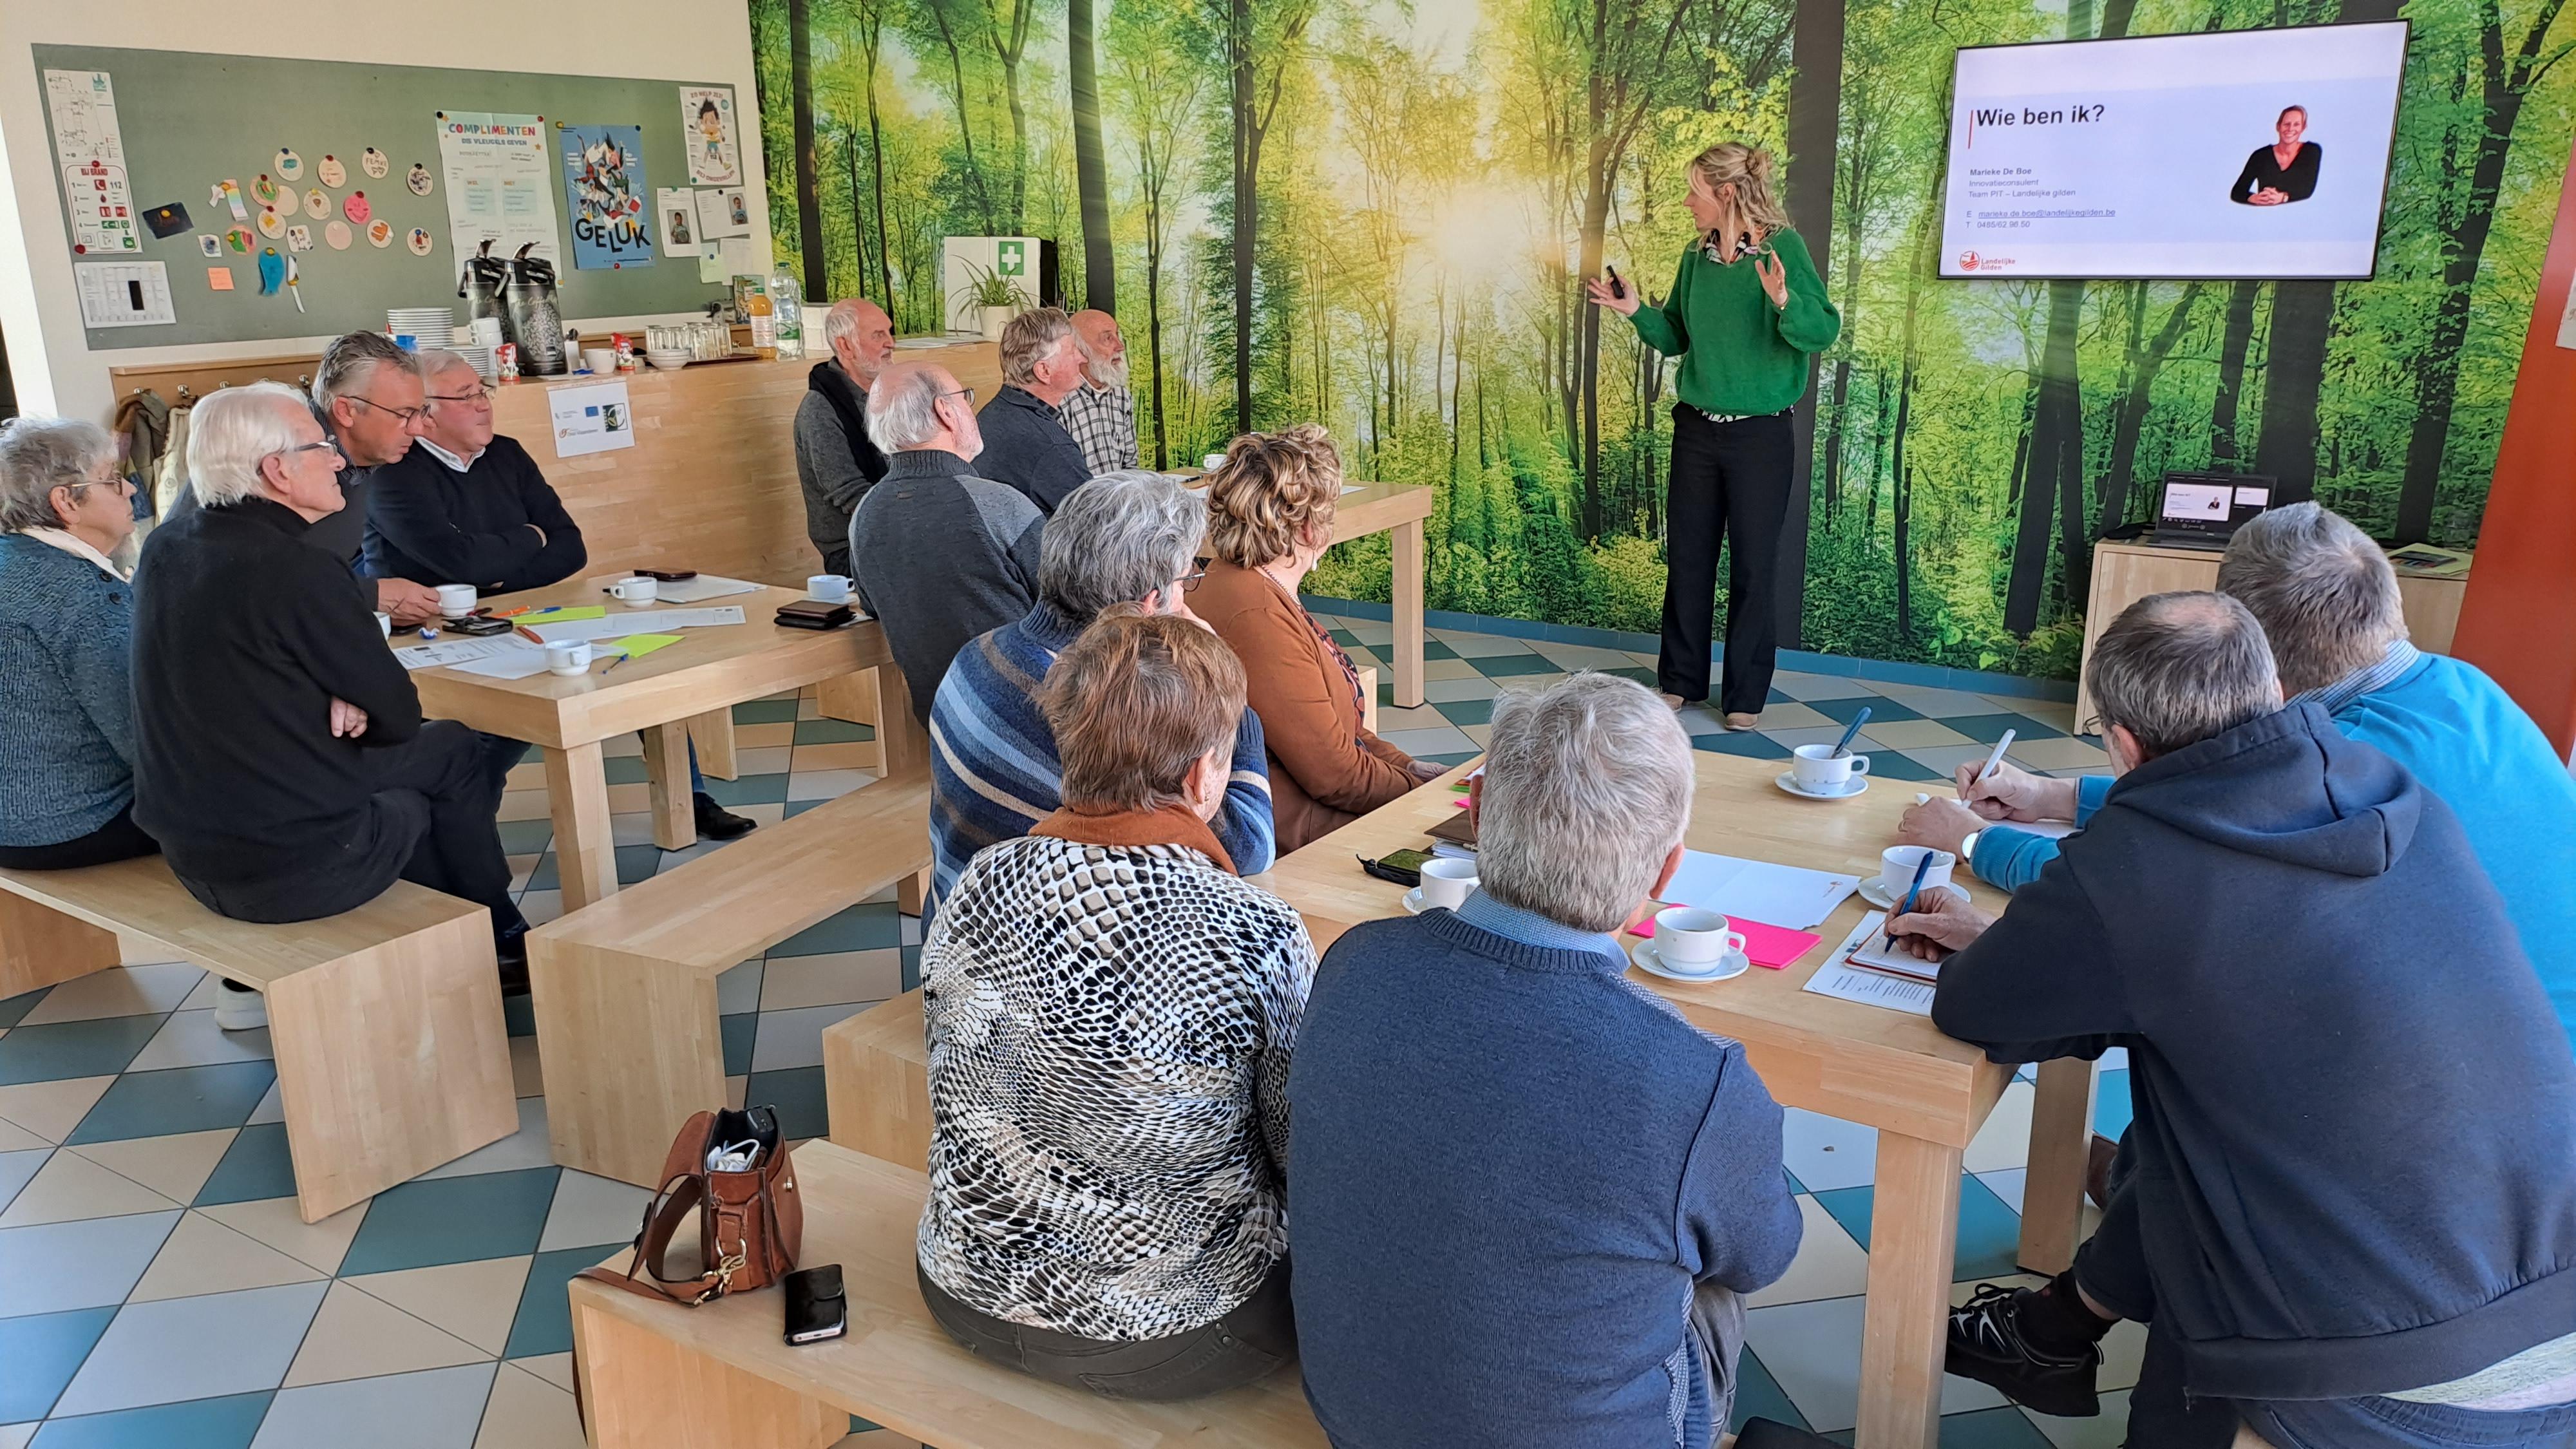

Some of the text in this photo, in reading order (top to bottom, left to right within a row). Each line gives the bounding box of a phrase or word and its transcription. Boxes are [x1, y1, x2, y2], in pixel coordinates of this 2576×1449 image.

[1976, 104, 2105, 127] Wie ben ik?
[448, 124, 536, 136] COMPLIMENTEN
[2012, 189, 2050, 198] Landelijke
[2052, 189, 2076, 198] gilden
[575, 218, 651, 253] GELUK
